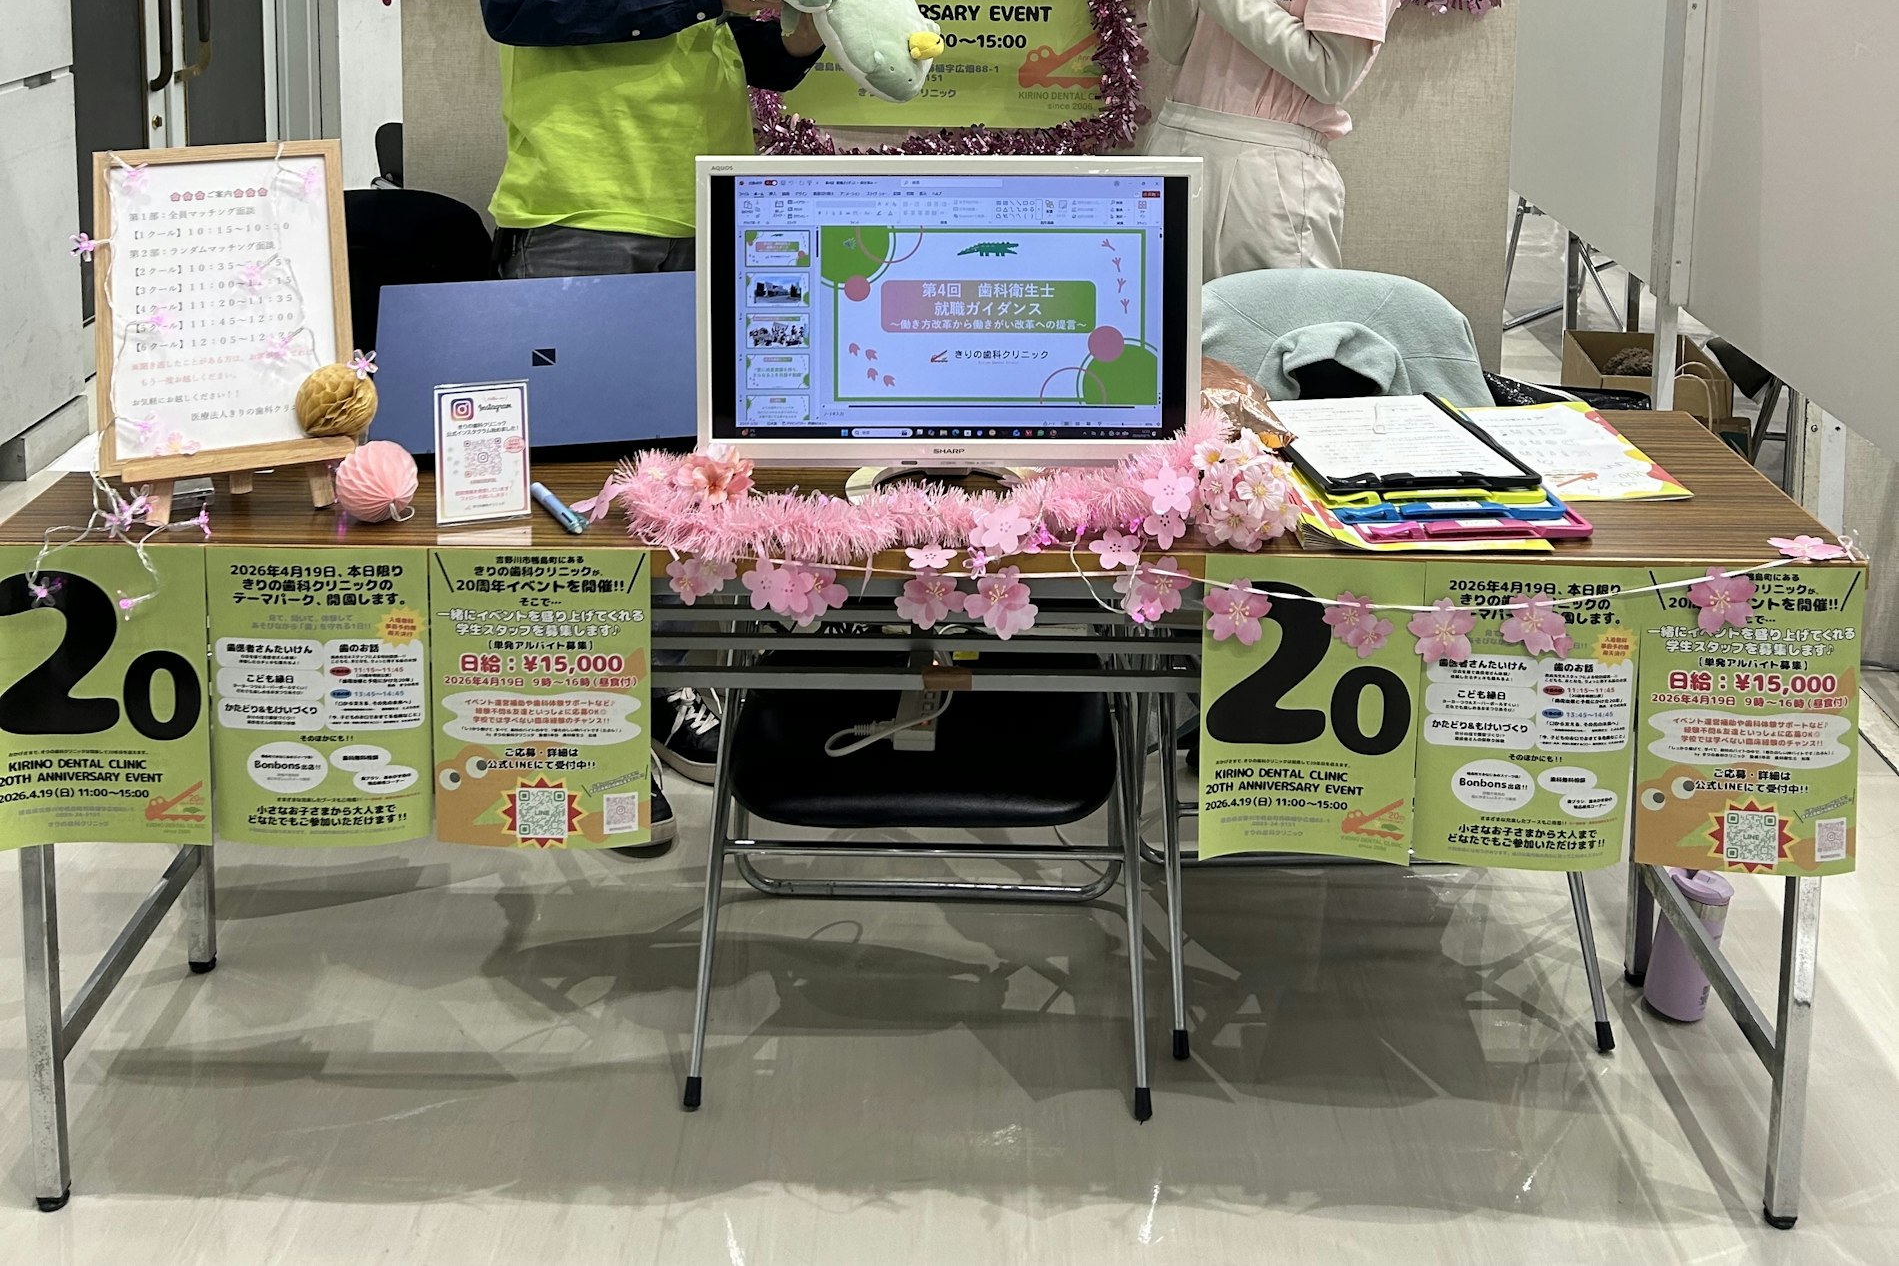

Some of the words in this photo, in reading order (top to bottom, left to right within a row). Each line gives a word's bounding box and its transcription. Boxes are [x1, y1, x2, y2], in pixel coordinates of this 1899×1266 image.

[989, 5, 1053, 23] EVENT
[1051, 91, 1086, 100] DENTAL
[207, 190, 233, 199] ご案内
[921, 282, 962, 299] 第4回
[977, 282, 1056, 299] 歯科衛生士
[933, 301, 1043, 316] 就職ガイダンス
[889, 319, 1088, 331] 〜働き方改革から働きがい改革への提言〜
[954, 349, 1050, 361] きりの歯科クリニック
[933, 447, 965, 455] SHARP
[230, 564, 404, 578] 2026年4月19日、本日限り
[241, 578, 393, 592] きりの歯科クリニックの
[456, 579, 625, 594] 20周年イベントを開催!!
[1449, 580, 1621, 595] 2026年4月19日、本日限り
[232, 592, 406, 607] テーマパーク、開園します。
[436, 609, 644, 624] 一緒にイベントを盛り上げてくれる
[226, 643, 313, 655] 歯医者さんたいけん
[339, 643, 380, 653] 歯のお話
[0, 570, 202, 741] 20
[1206, 580, 1412, 756] 20
[1439, 658, 1528, 671] 歯医者さんたいけん
[1554, 663, 1594, 673] 歯のお話
[246, 674, 295, 684] こども縁日
[444, 676, 524, 687] 2026年4月19日
[1457, 690, 1506, 700] こども縁日
[1651, 693, 1736, 706] 2026年4月19日
[224, 703, 318, 715] かたどり&もけいづくり
[1432, 719, 1529, 733] かたどり&もけいづくり
[504, 747, 579, 758] ご応募・詳細は
[1508, 753, 1563, 763] そのほかにも!!
[8, 759, 53, 772] KIRINO
[58, 759, 104, 770] DENTAL
[109, 759, 147, 770] CLINIC
[487, 759, 597, 771] 公式LINEにて受付中!!
[0, 773, 32, 787] 20TH
[37, 772, 120, 783] ANNIVERSARY
[125, 773, 164, 783] EVENT
[1215, 768, 1254, 780] KIRINO
[1258, 768, 1305, 779] DENTAL
[1309, 770, 1349, 782] CLINIC
[1713, 768, 1792, 782] ご応募・詳細は
[1205, 782, 1234, 795] 20TH
[1238, 781, 1320, 793] ANNIVERSARY
[1325, 784, 1365, 796] EVENT
[1694, 779, 1810, 794] 公式LINEにて受付中!!
[256, 804, 396, 816] 小さなお子さまから大人まで
[1205, 796, 1272, 811] 2026.4.19（日）
[247, 813, 408, 827] どなたでもご参加いただけます!!
[1458, 824, 1598, 840] 小さなお子さまから大人まで
[1447, 832, 1606, 850] どなたでもご参加いただけます!!
